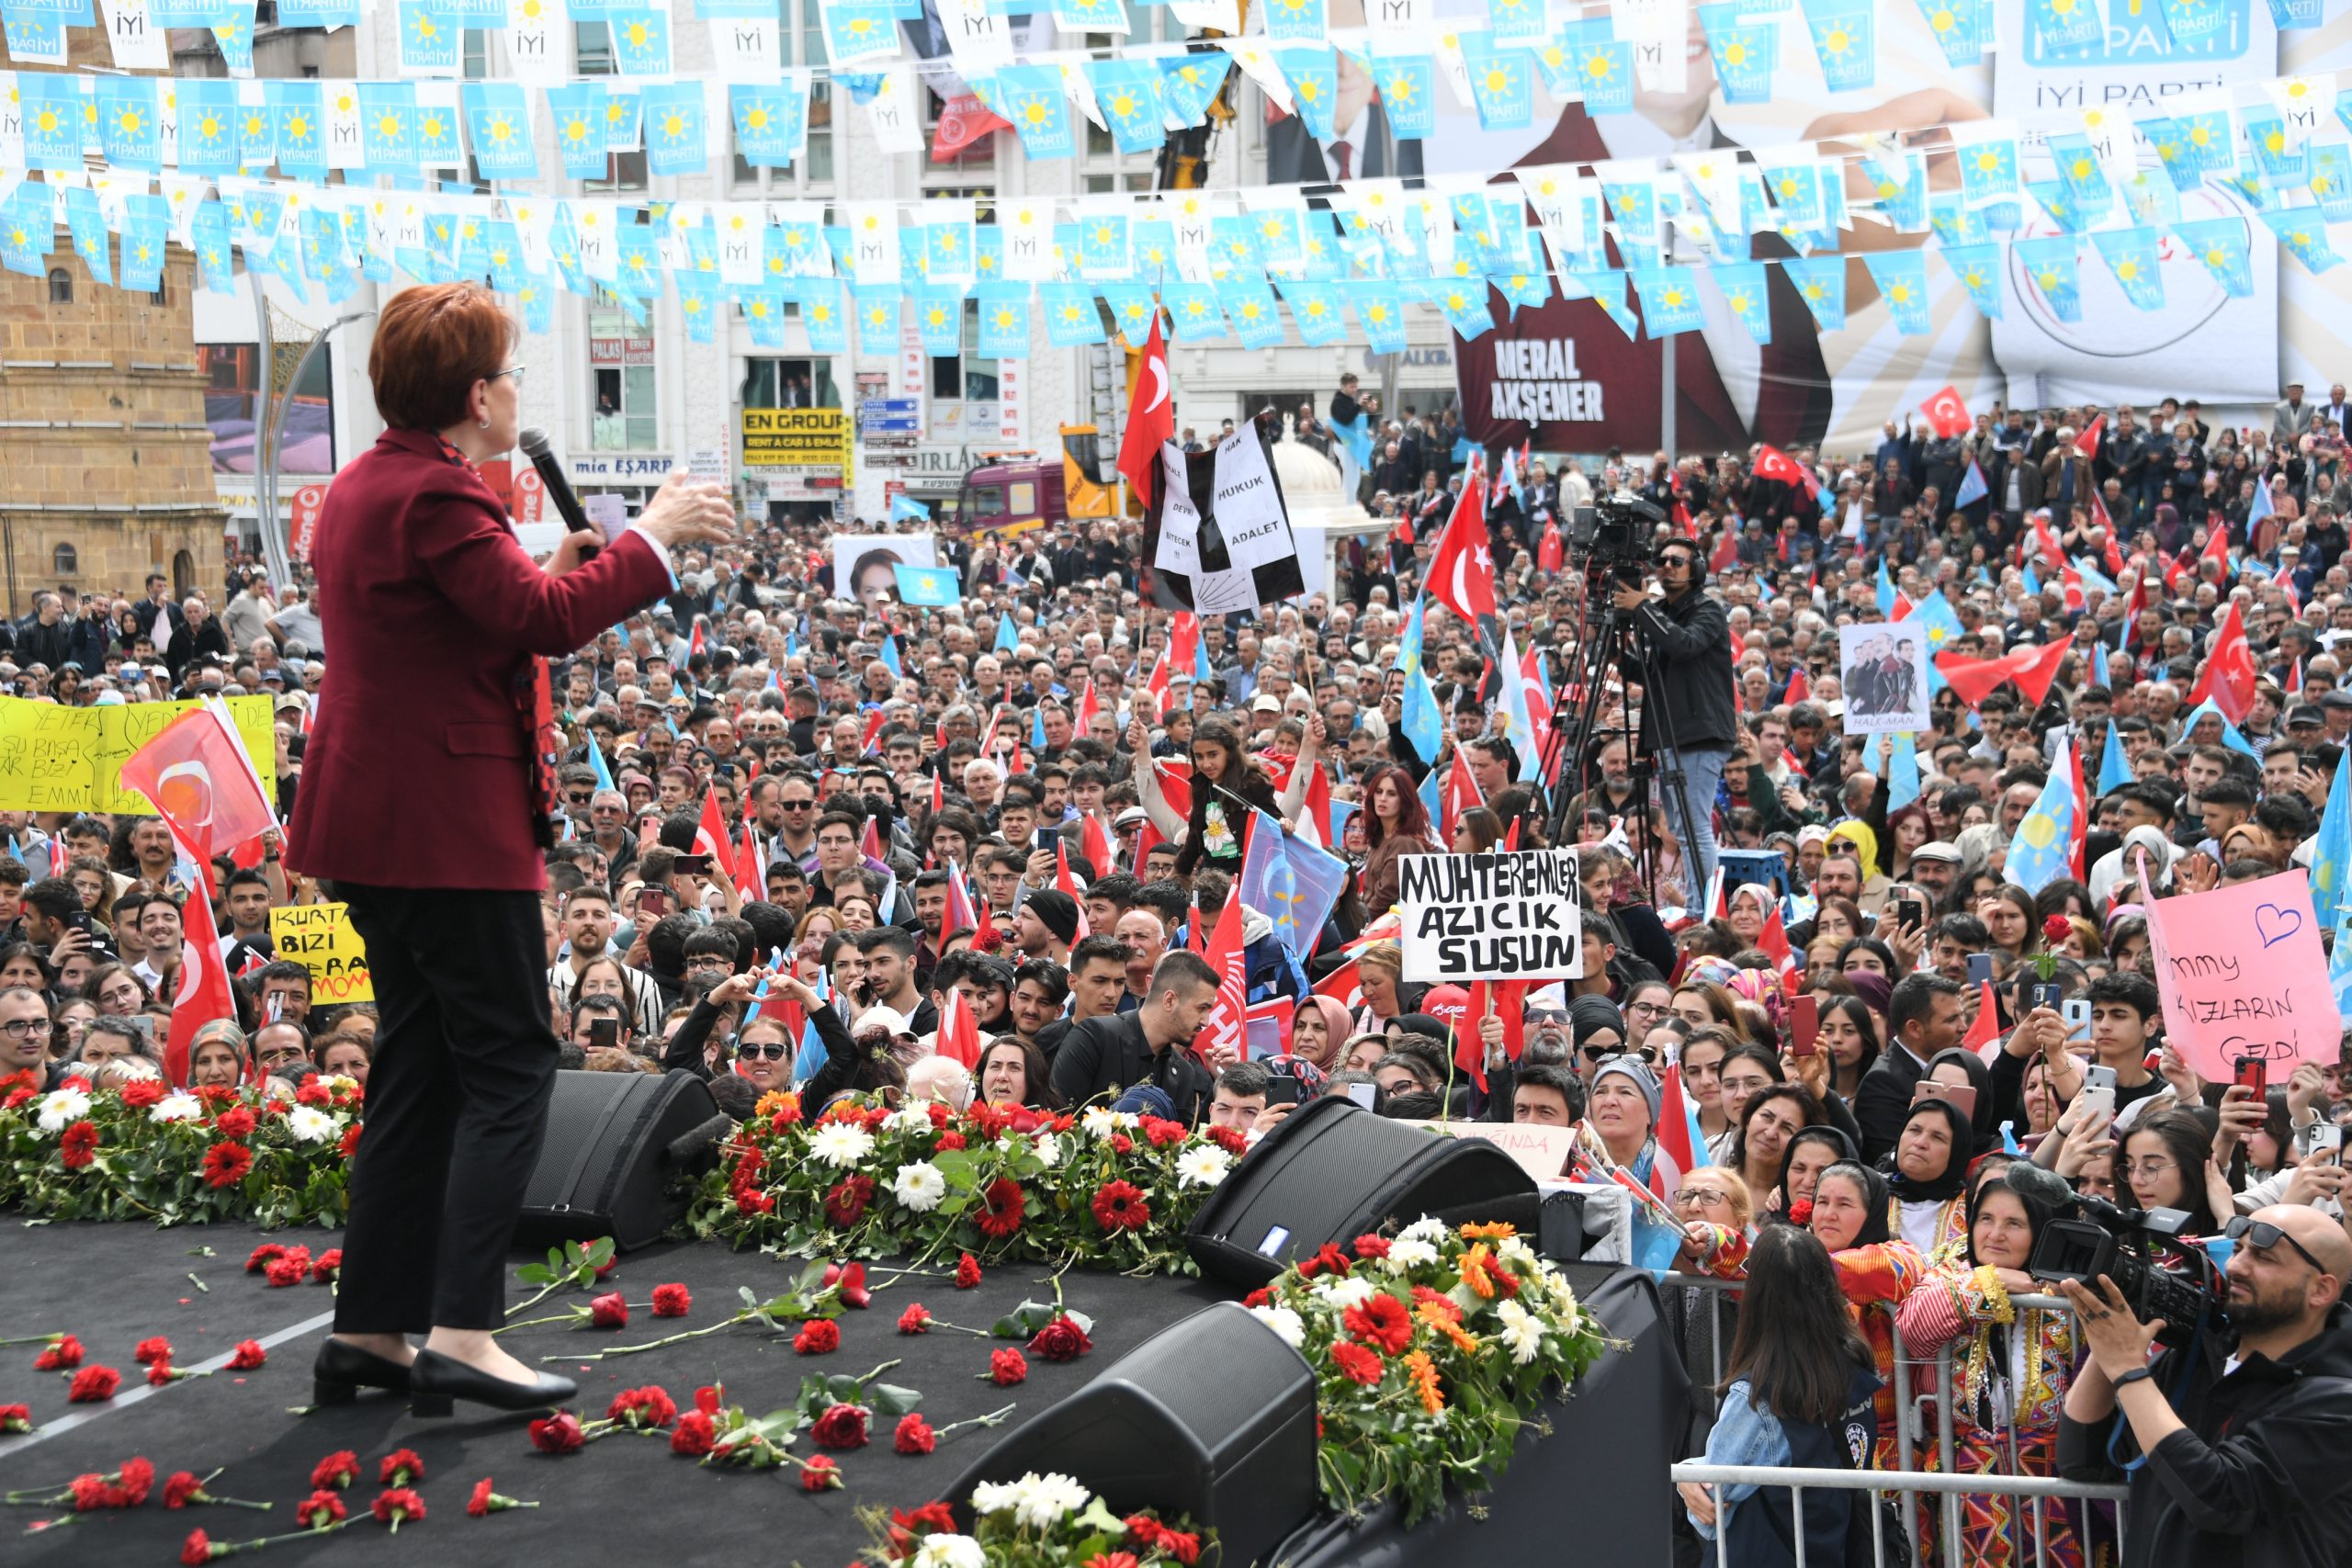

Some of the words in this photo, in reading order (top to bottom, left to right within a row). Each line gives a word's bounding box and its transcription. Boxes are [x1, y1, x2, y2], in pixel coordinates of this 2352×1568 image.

[117, 11, 143, 35] İYİ
[964, 13, 993, 37] İYİ
[517, 30, 545, 54] İYİ
[735, 28, 762, 51] İYİ
[1635, 42, 1661, 64] İYİ
[2036, 81, 2085, 107] İYİ
[876, 106, 899, 128] İYİ
[334, 122, 356, 143] İYİ
[2092, 137, 2112, 161] Yİ
[580, 234, 600, 257] İYİ
[1014, 236, 1036, 256] İYİ
[1181, 226, 1204, 245] İYİ
[726, 241, 748, 261] İYİ
[861, 241, 883, 261] İYİ
[1494, 338, 1580, 379] MERAL
[1491, 380, 1604, 429] AKŞENER
[745, 414, 772, 429] EN
[748, 438, 773, 447] RENT
[775, 438, 782, 447] A
[784, 438, 804, 447] CAR
[816, 438, 842, 447] EMLA
[575, 457, 607, 473] mia
[616, 459, 673, 479] EŞARP
[1218, 476, 1264, 501] HUKUK
[1231, 520, 1279, 546] ADALET
[1401, 852, 1577, 905] MUHTEREMLER
[1418, 901, 1559, 939] AZICIK
[281, 925, 334, 953] BİZİ
[1439, 934, 1575, 973] SUSUN
